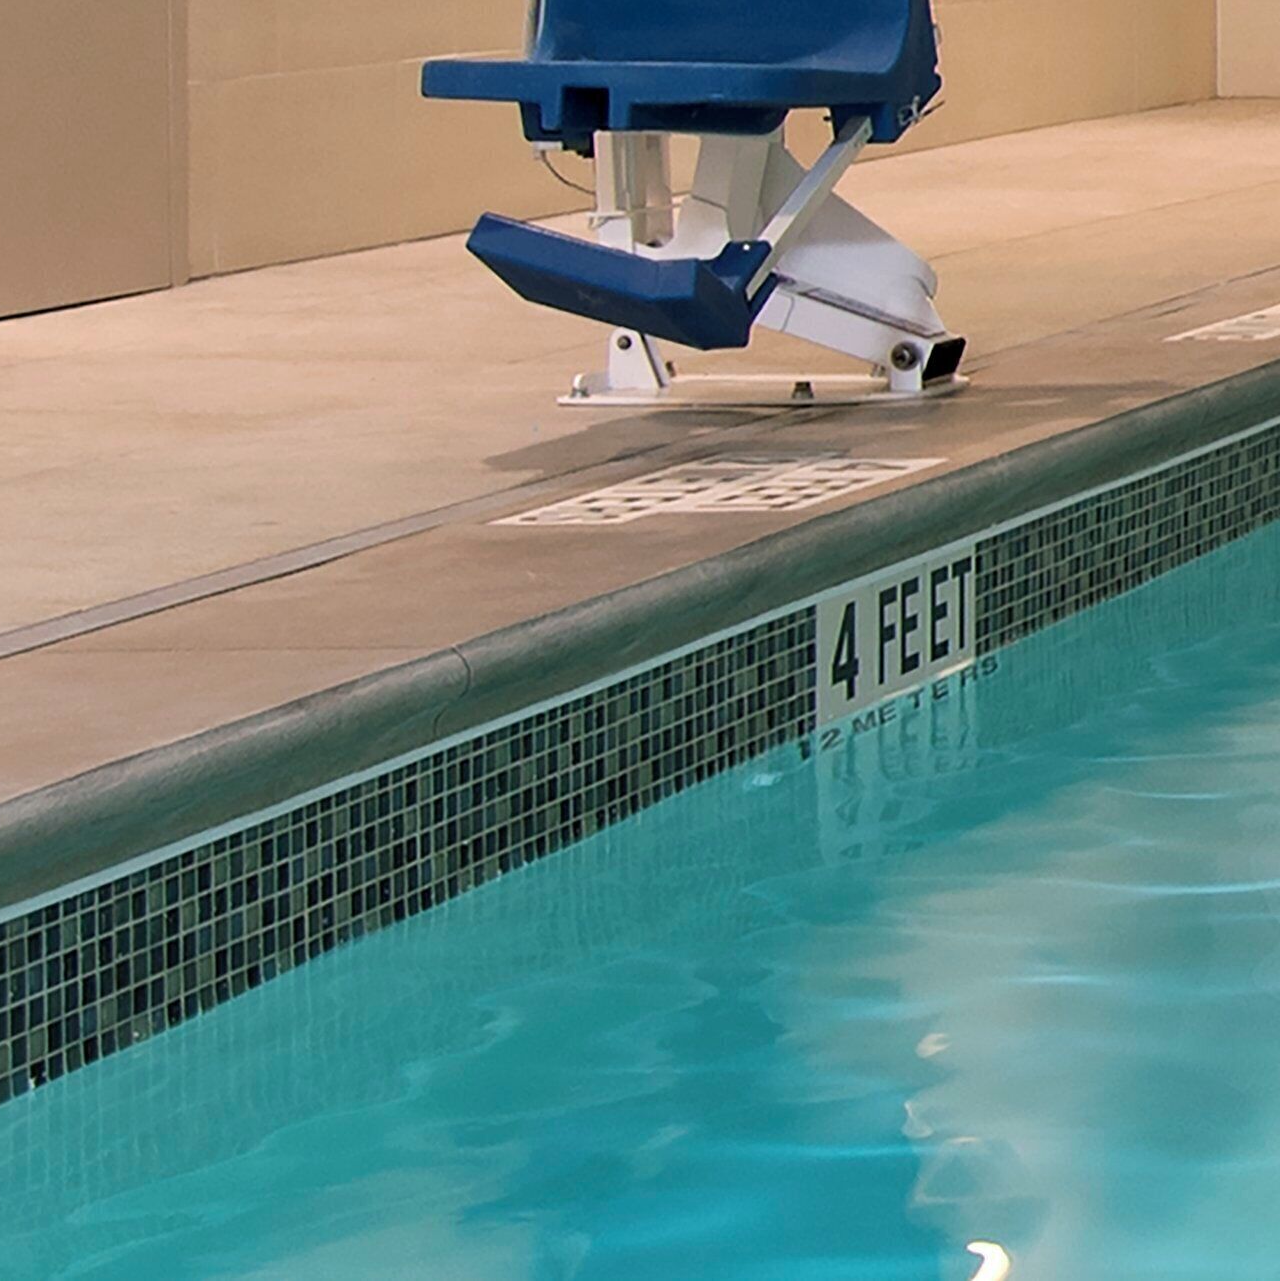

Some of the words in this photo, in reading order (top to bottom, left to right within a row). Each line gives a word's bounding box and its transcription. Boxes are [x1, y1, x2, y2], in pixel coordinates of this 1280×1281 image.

[830, 600, 859, 701] 4
[878, 554, 973, 685] FEET
[851, 655, 998, 735] METERS
